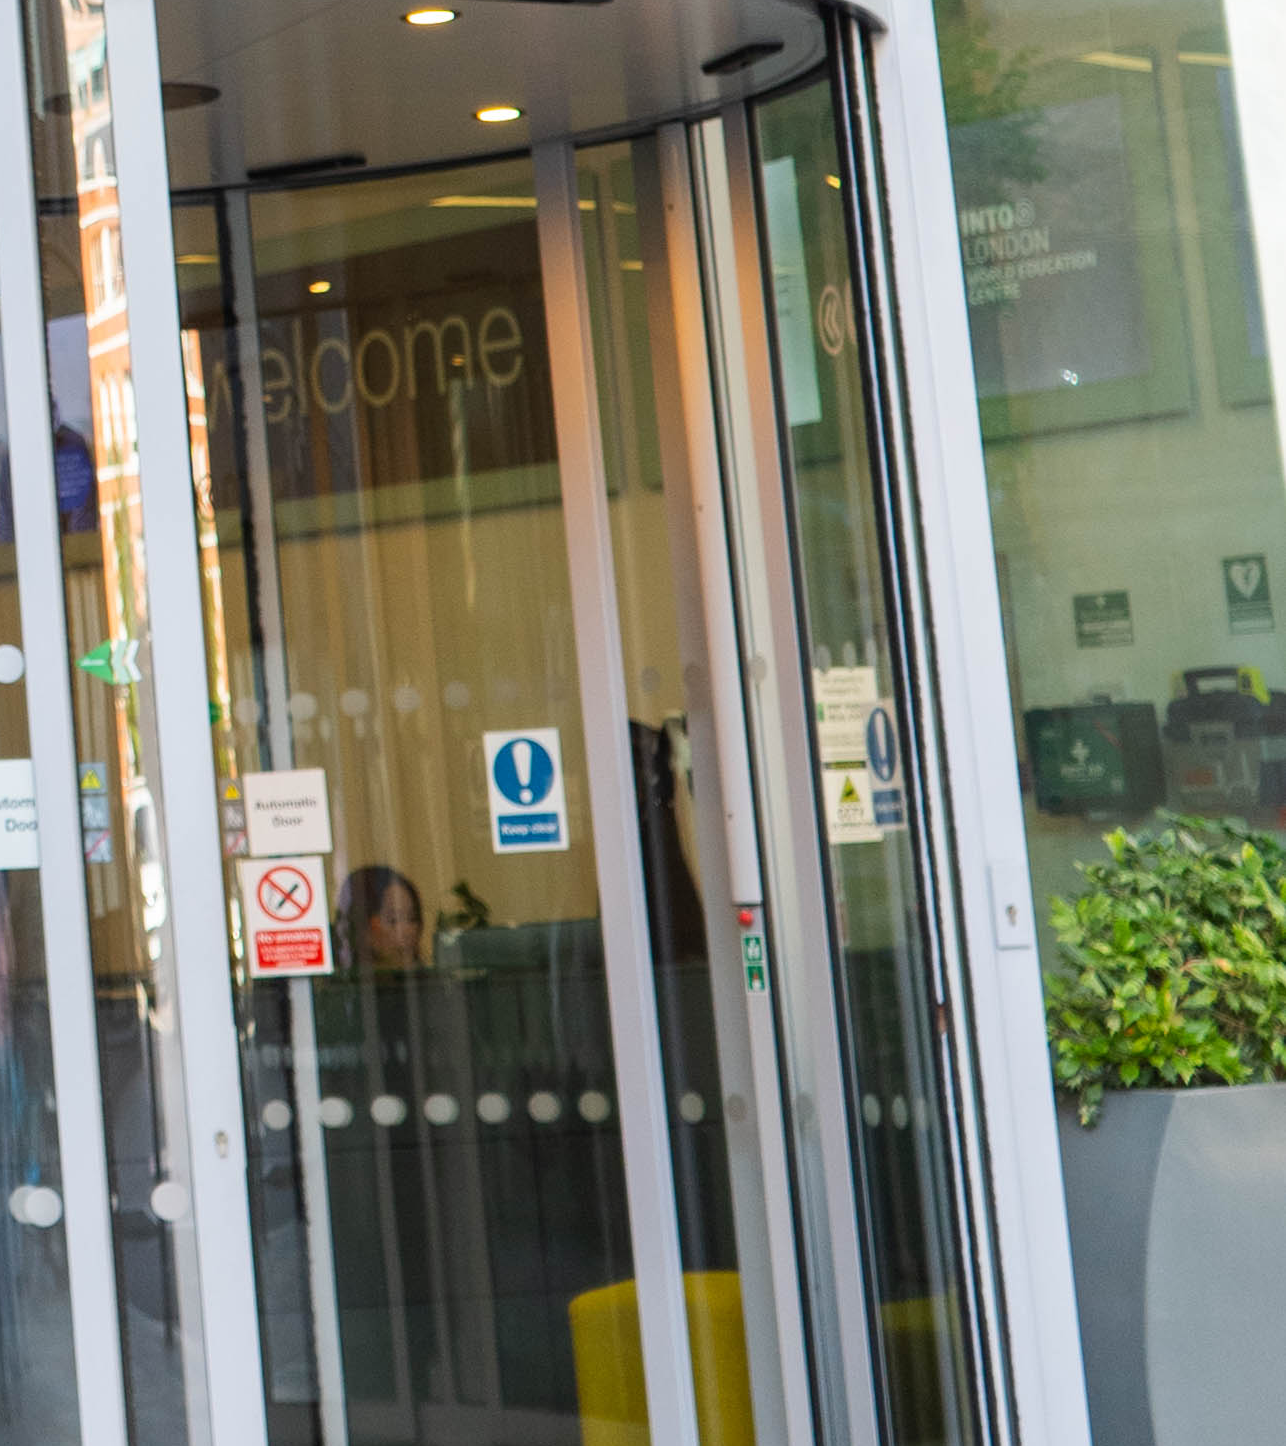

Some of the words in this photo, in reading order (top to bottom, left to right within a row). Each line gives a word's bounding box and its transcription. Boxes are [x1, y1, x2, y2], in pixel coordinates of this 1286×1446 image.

[961, 204, 1014, 235] INTO
[964, 226, 1050, 265] LONDON
[254, 798, 317, 811] Automatic
[272, 815, 303, 828] Door
[501, 823, 529, 836] Keep
